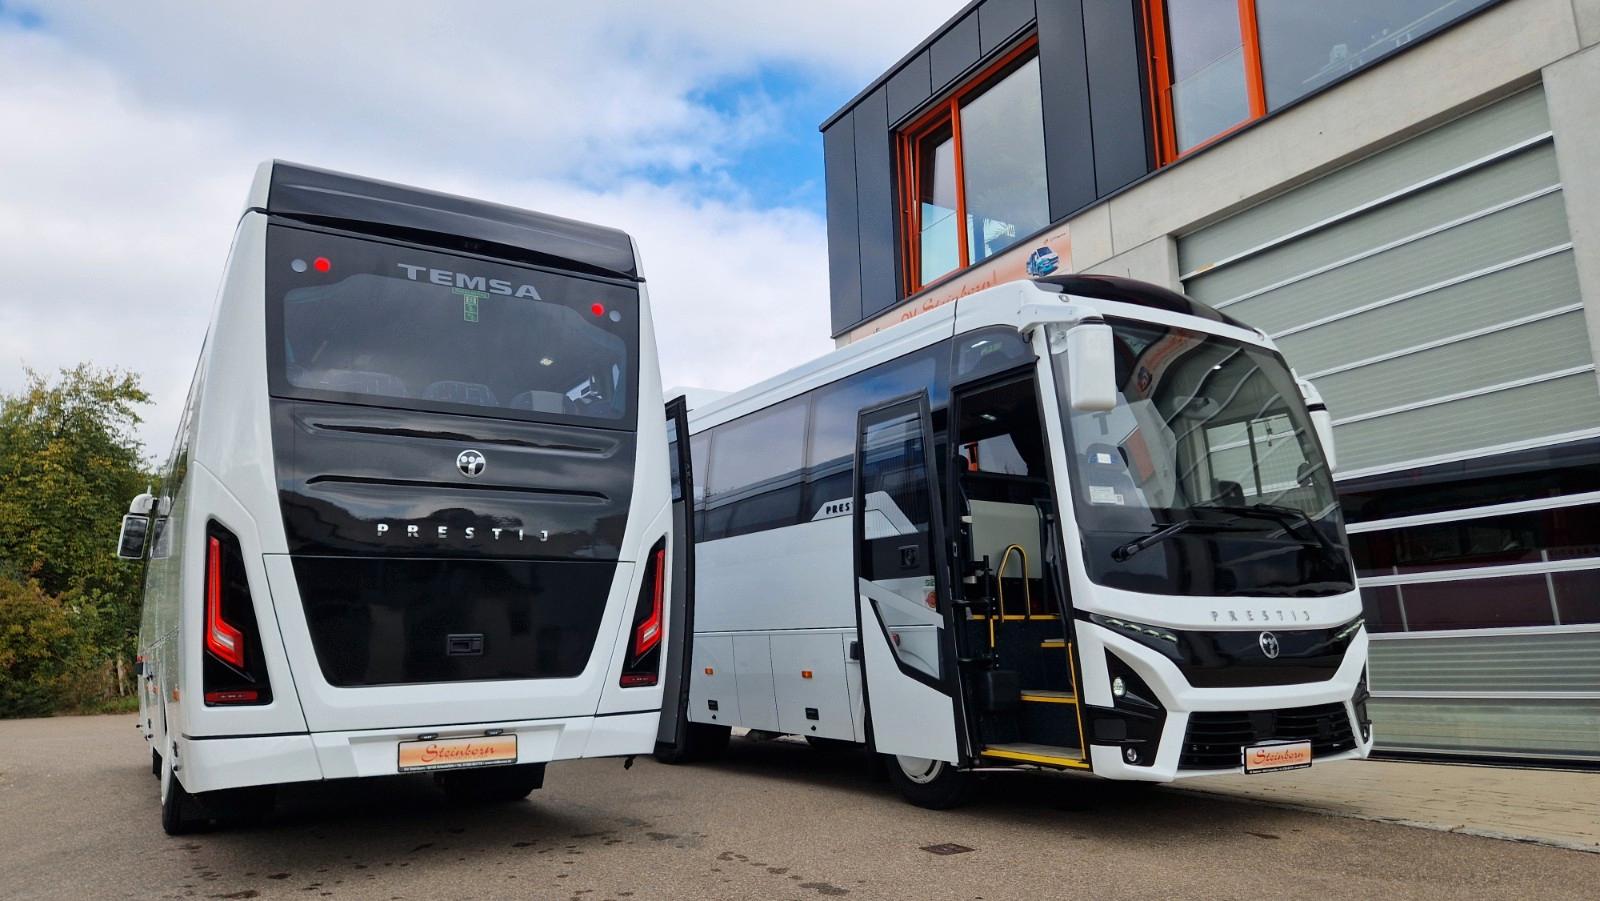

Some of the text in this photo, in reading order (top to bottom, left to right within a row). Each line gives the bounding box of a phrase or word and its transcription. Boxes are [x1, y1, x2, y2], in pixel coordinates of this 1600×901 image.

[397, 263, 542, 301] TEMSA
[826, 501, 854, 515] PRES
[377, 523, 549, 542] PRESTIJ
[1211, 610, 1310, 621] PRESTIJ
[421, 744, 496, 763] Steinborn
[1253, 749, 1304, 764] Steinborn
